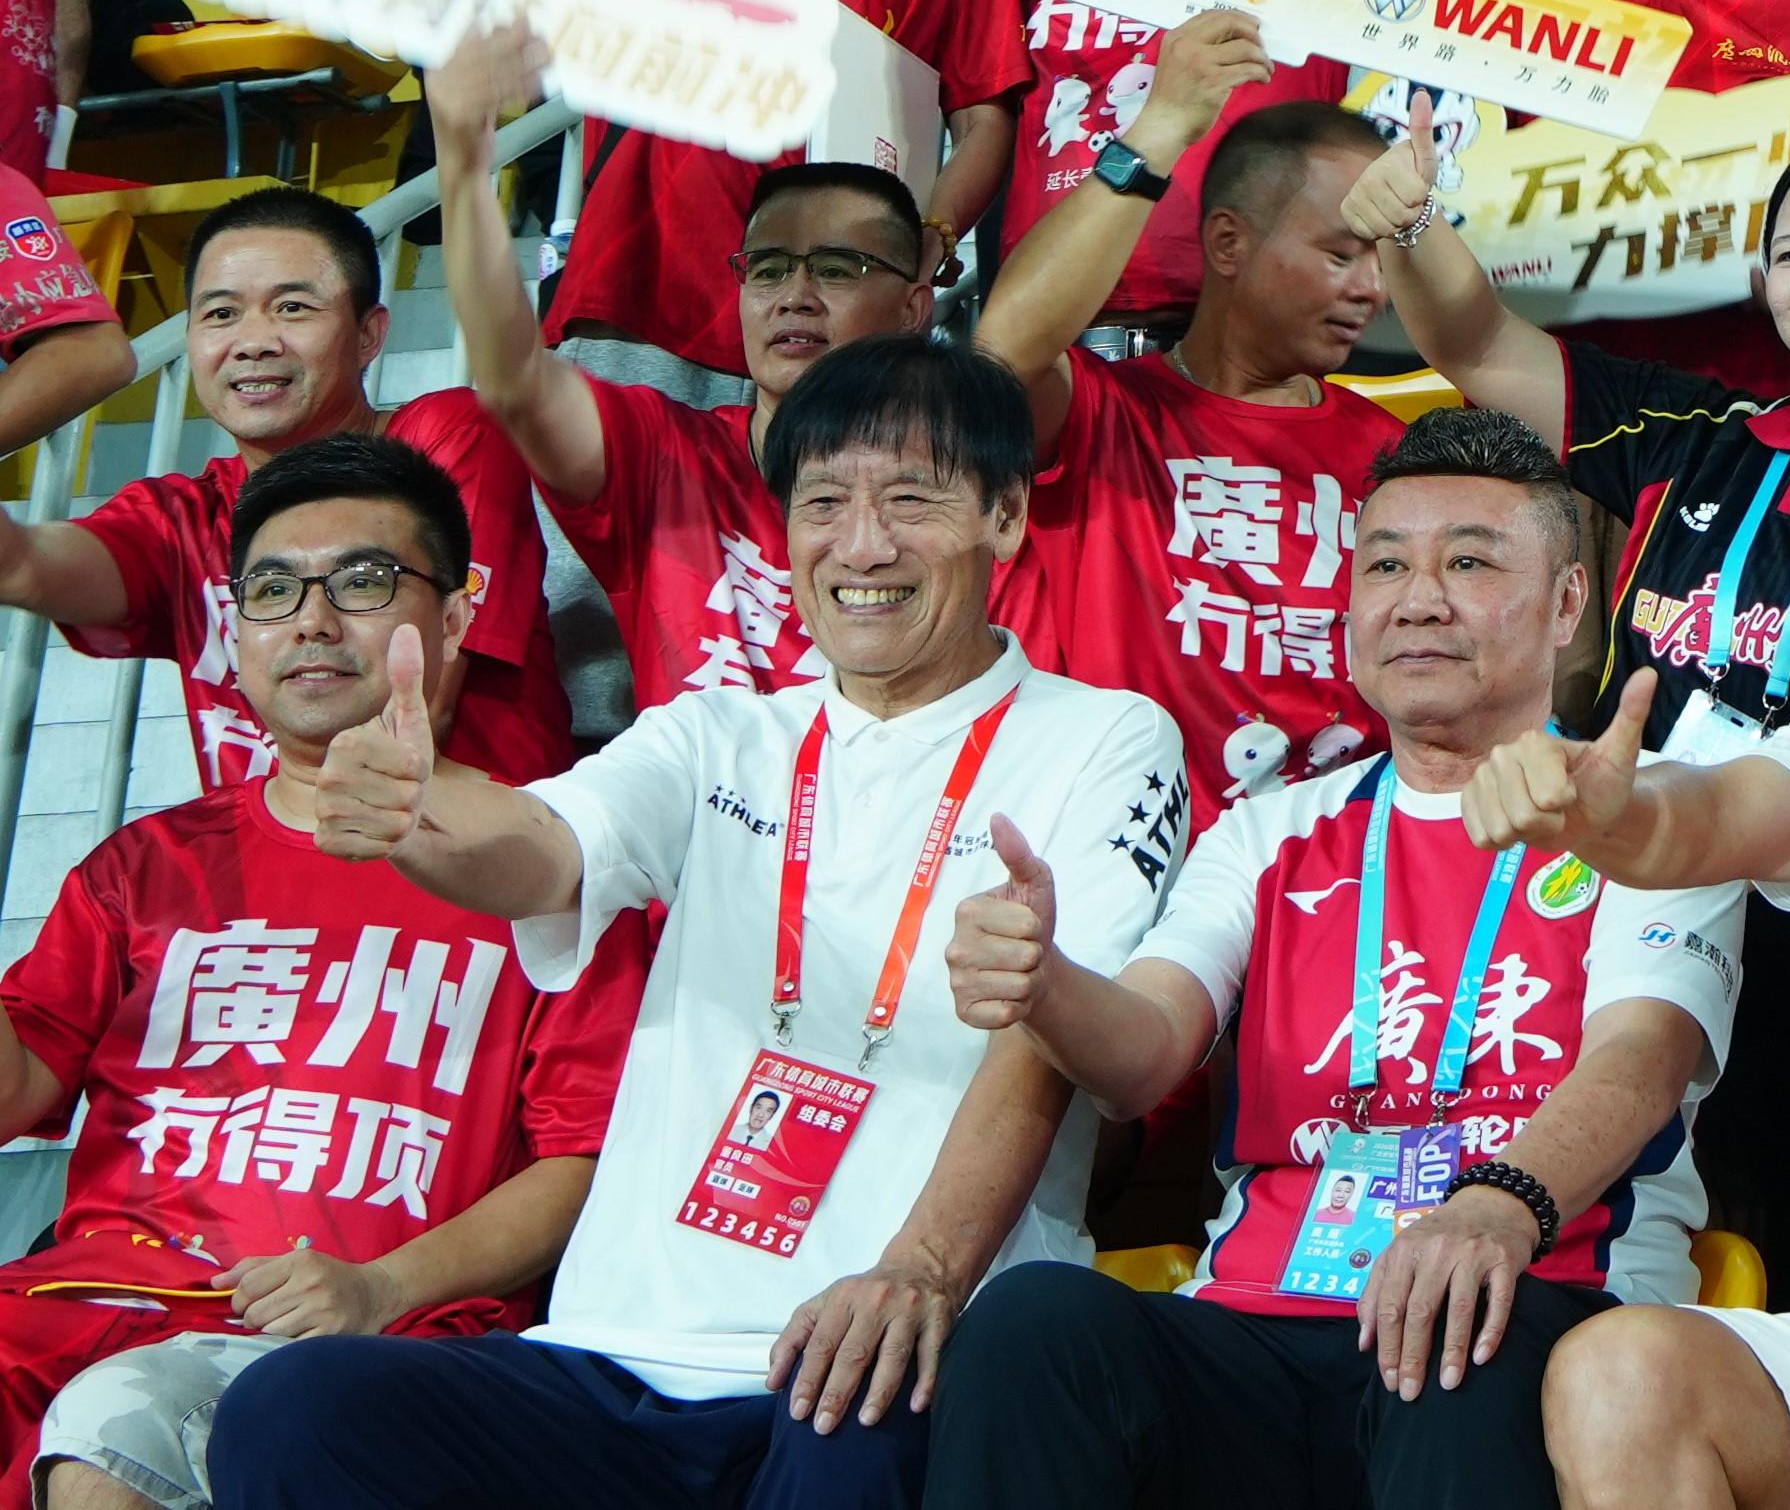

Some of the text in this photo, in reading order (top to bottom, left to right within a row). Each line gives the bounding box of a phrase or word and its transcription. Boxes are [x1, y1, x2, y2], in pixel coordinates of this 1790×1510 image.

[1570, 199, 1768, 291] 力撑
[1165, 577, 1355, 681] 冇得
[707, 793, 778, 837] ATHLEA
[134, 918, 507, 1096] 廣州
[1303, 939, 1565, 1086] 廣東
[755, 1057, 871, 1106] 广东体育城市联赛
[797, 1103, 848, 1134] 组委会
[1330, 1082, 1553, 1110] GANGDONG
[128, 1086, 453, 1222] 冇得顶
[1416, 1142, 1453, 1202] FOP
